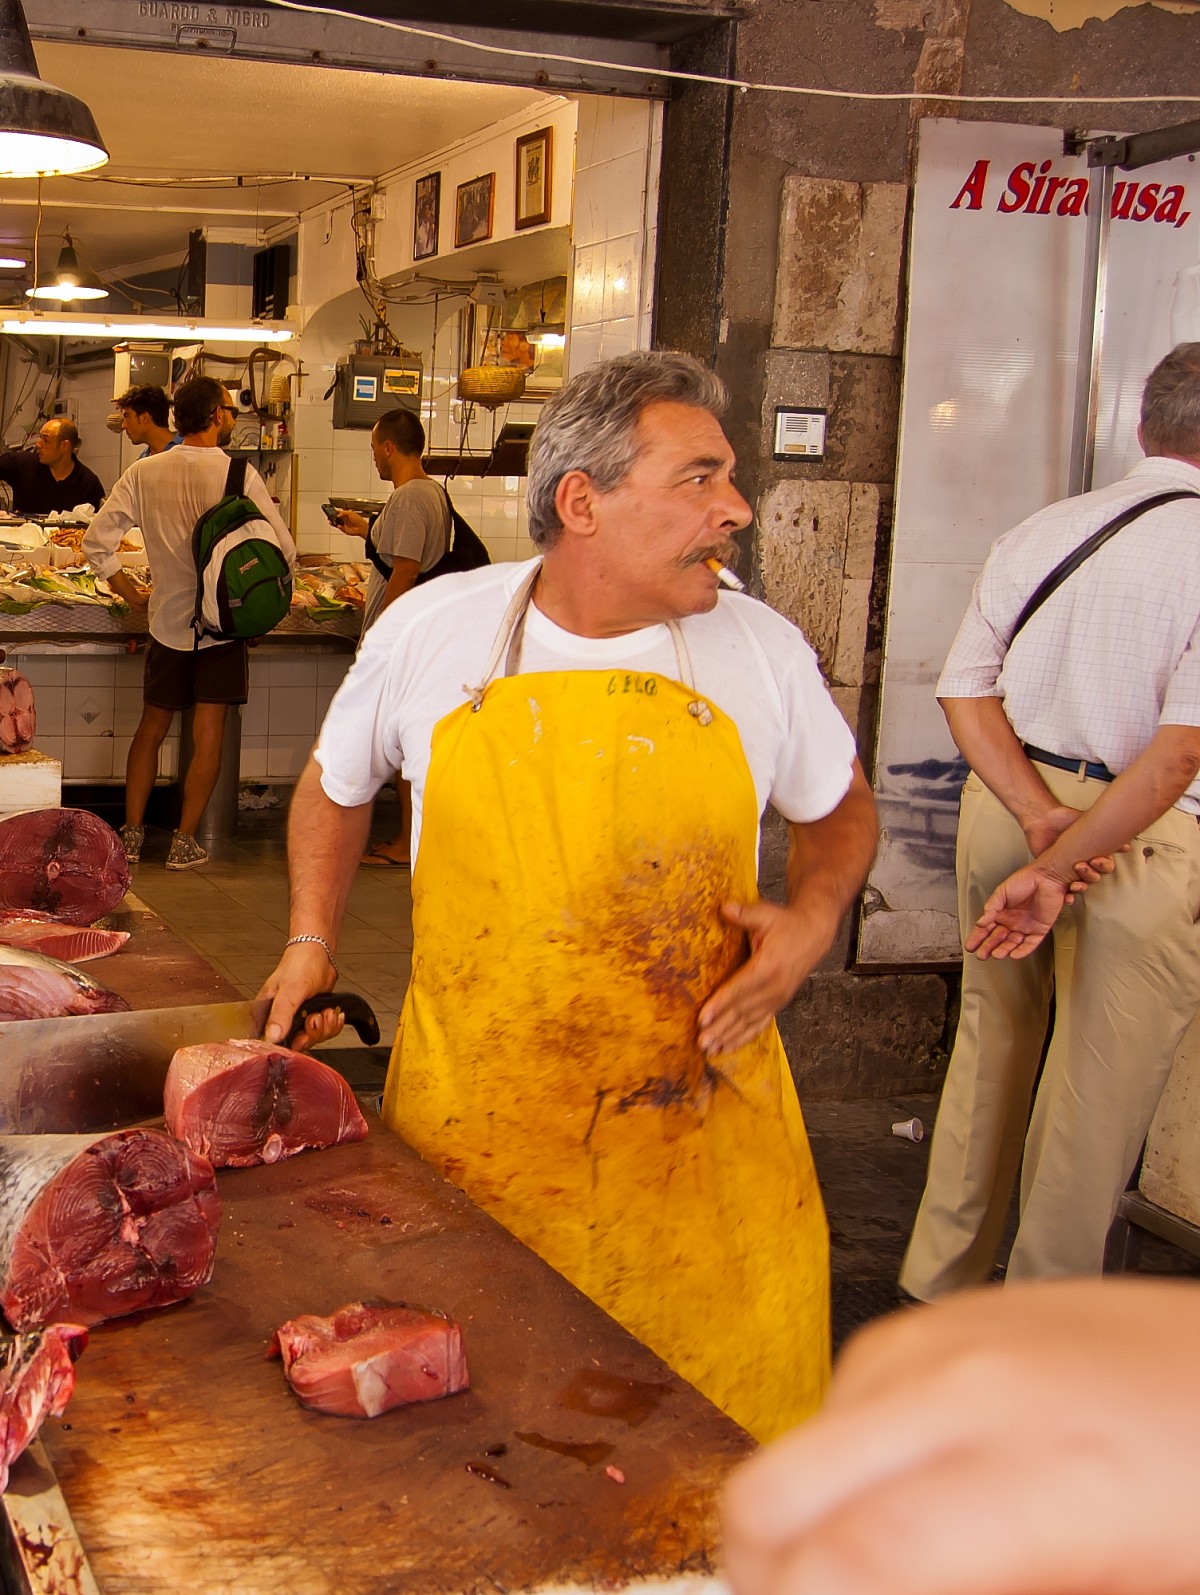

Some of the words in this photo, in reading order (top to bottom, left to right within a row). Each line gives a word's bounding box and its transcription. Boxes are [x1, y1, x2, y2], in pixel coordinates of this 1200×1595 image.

[138, 1, 199, 22] GUARDO
[207, 8, 218, 24] &
[225, 8, 271, 29] NIGRO
[949, 159, 991, 211] A
[996, 159, 1192, 229] Sirausa,
